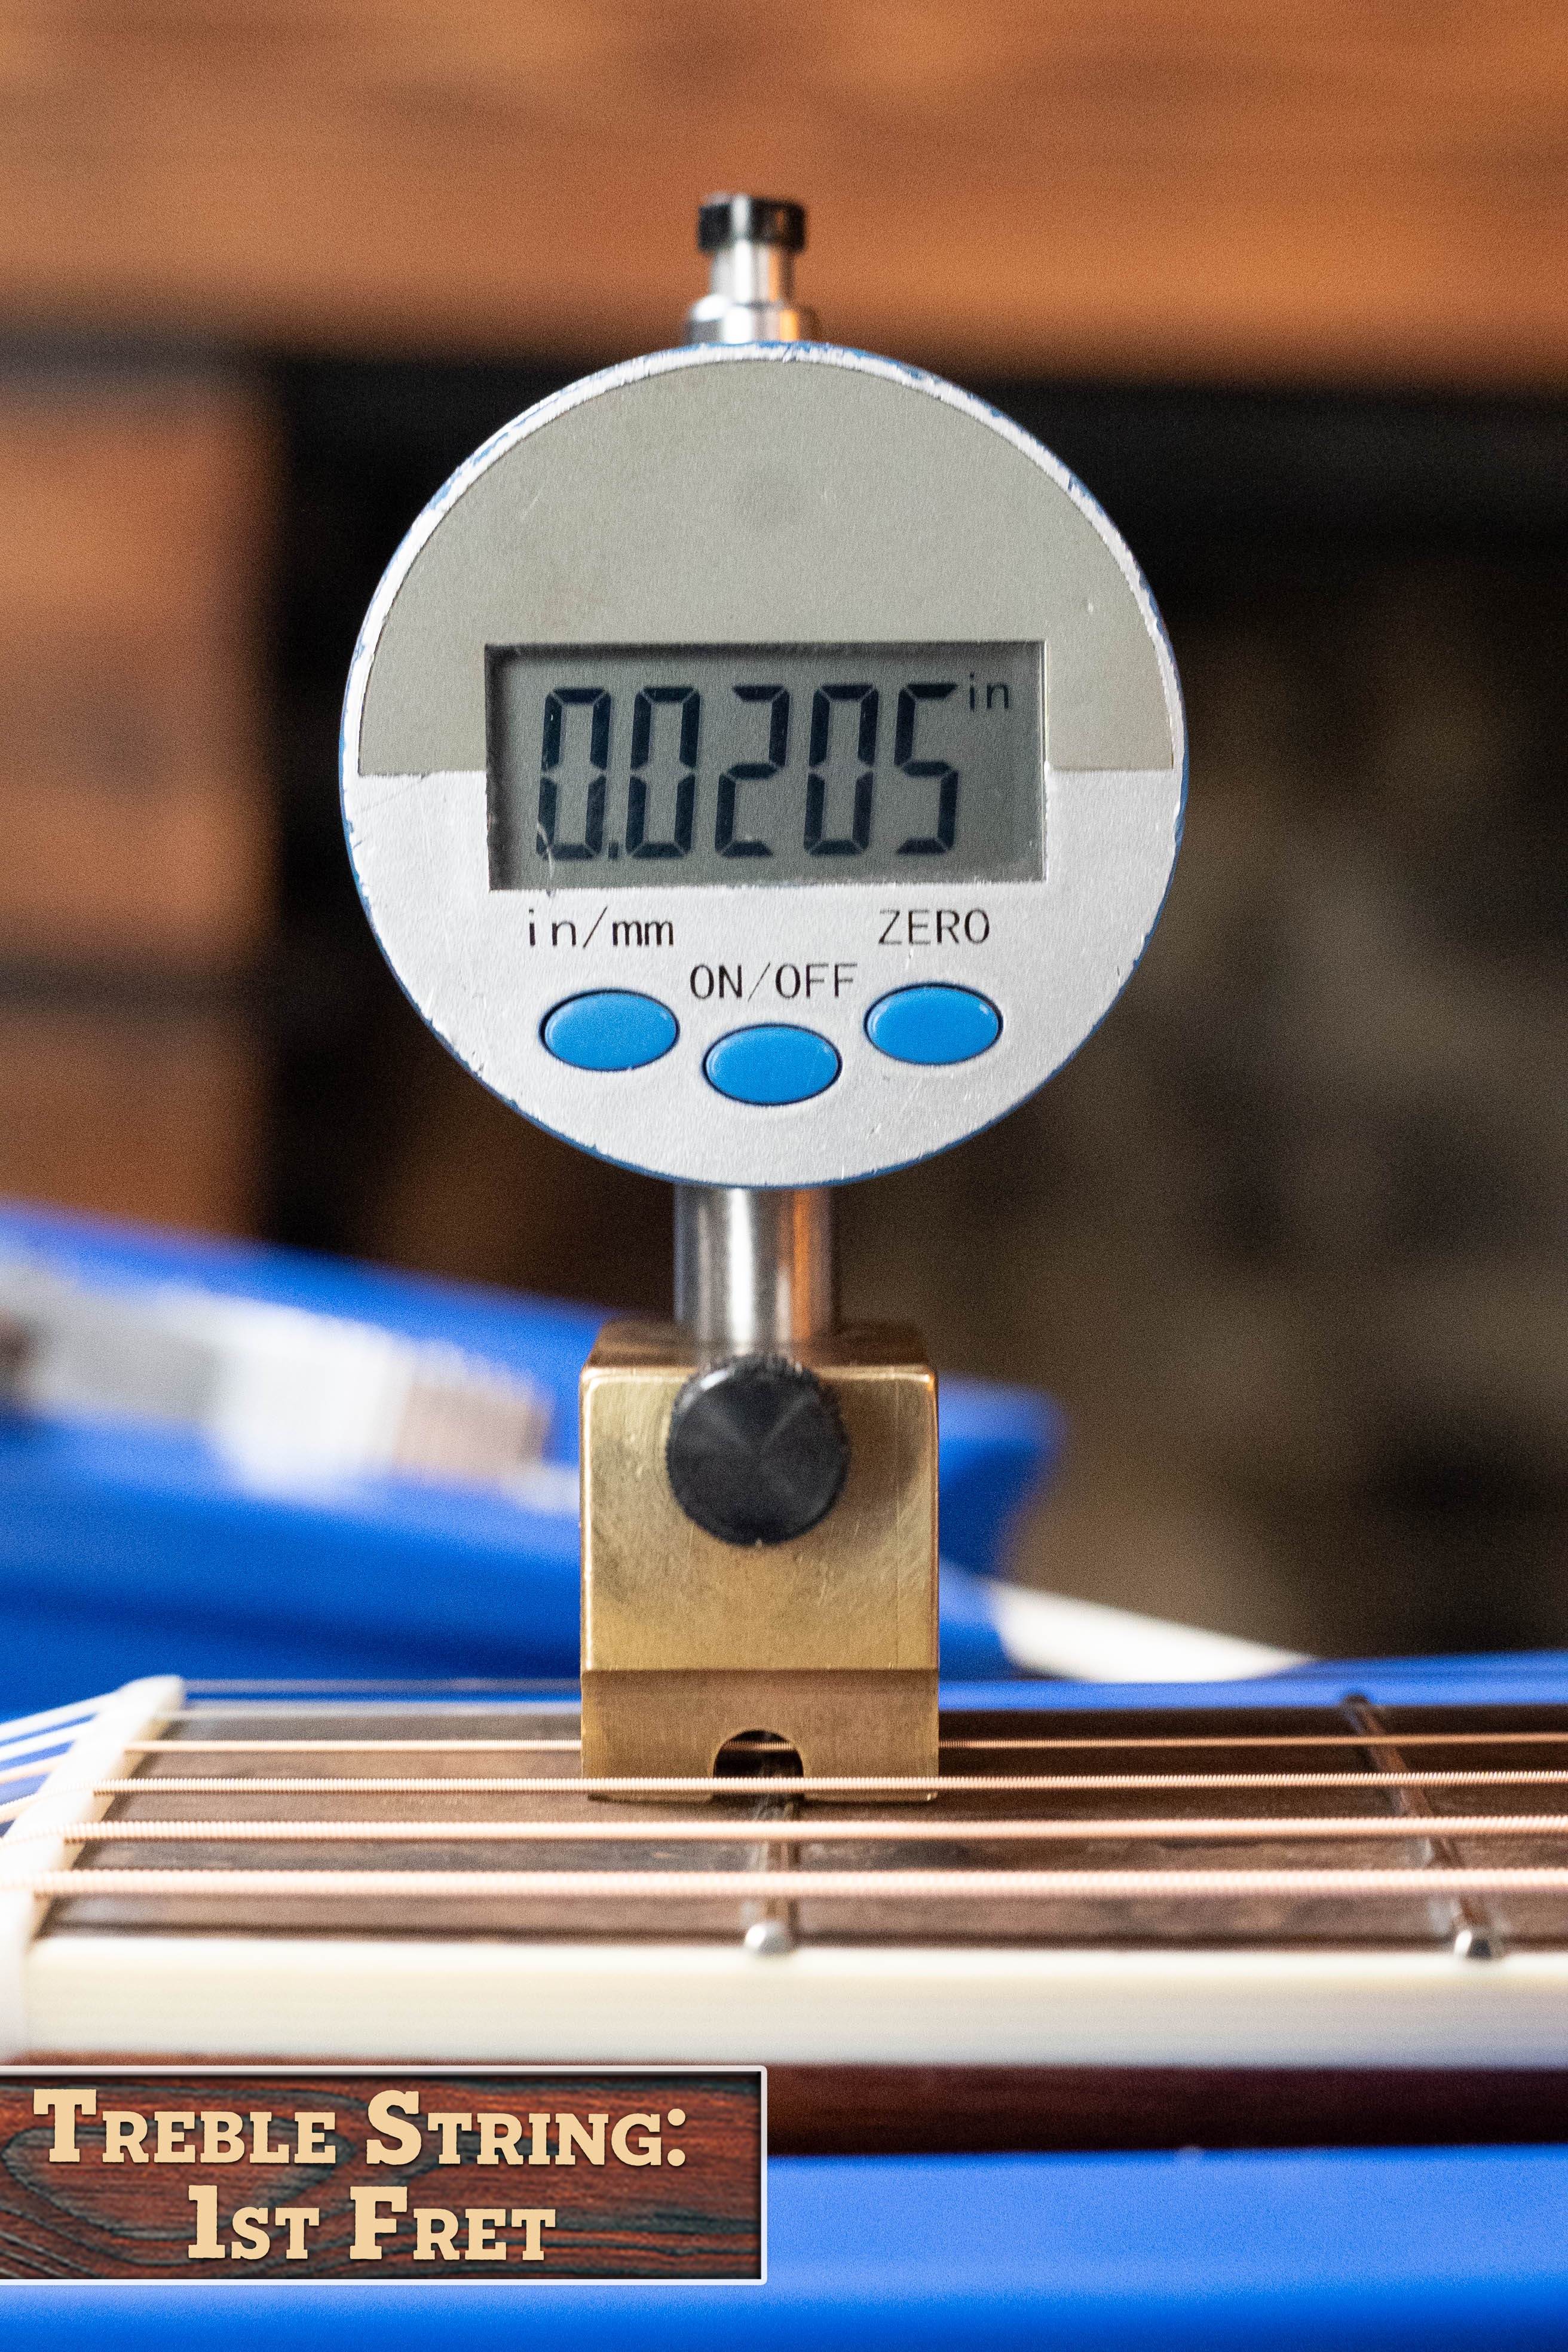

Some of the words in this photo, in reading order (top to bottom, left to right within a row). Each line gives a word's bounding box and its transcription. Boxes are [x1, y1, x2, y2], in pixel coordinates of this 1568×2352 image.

[536, 684, 958, 859] 0.0205
[969, 673, 1010, 712] in
[528, 906, 674, 949] in/mm
[878, 908, 991, 945] ZERO
[690, 961, 859, 1003] ON/OFF
